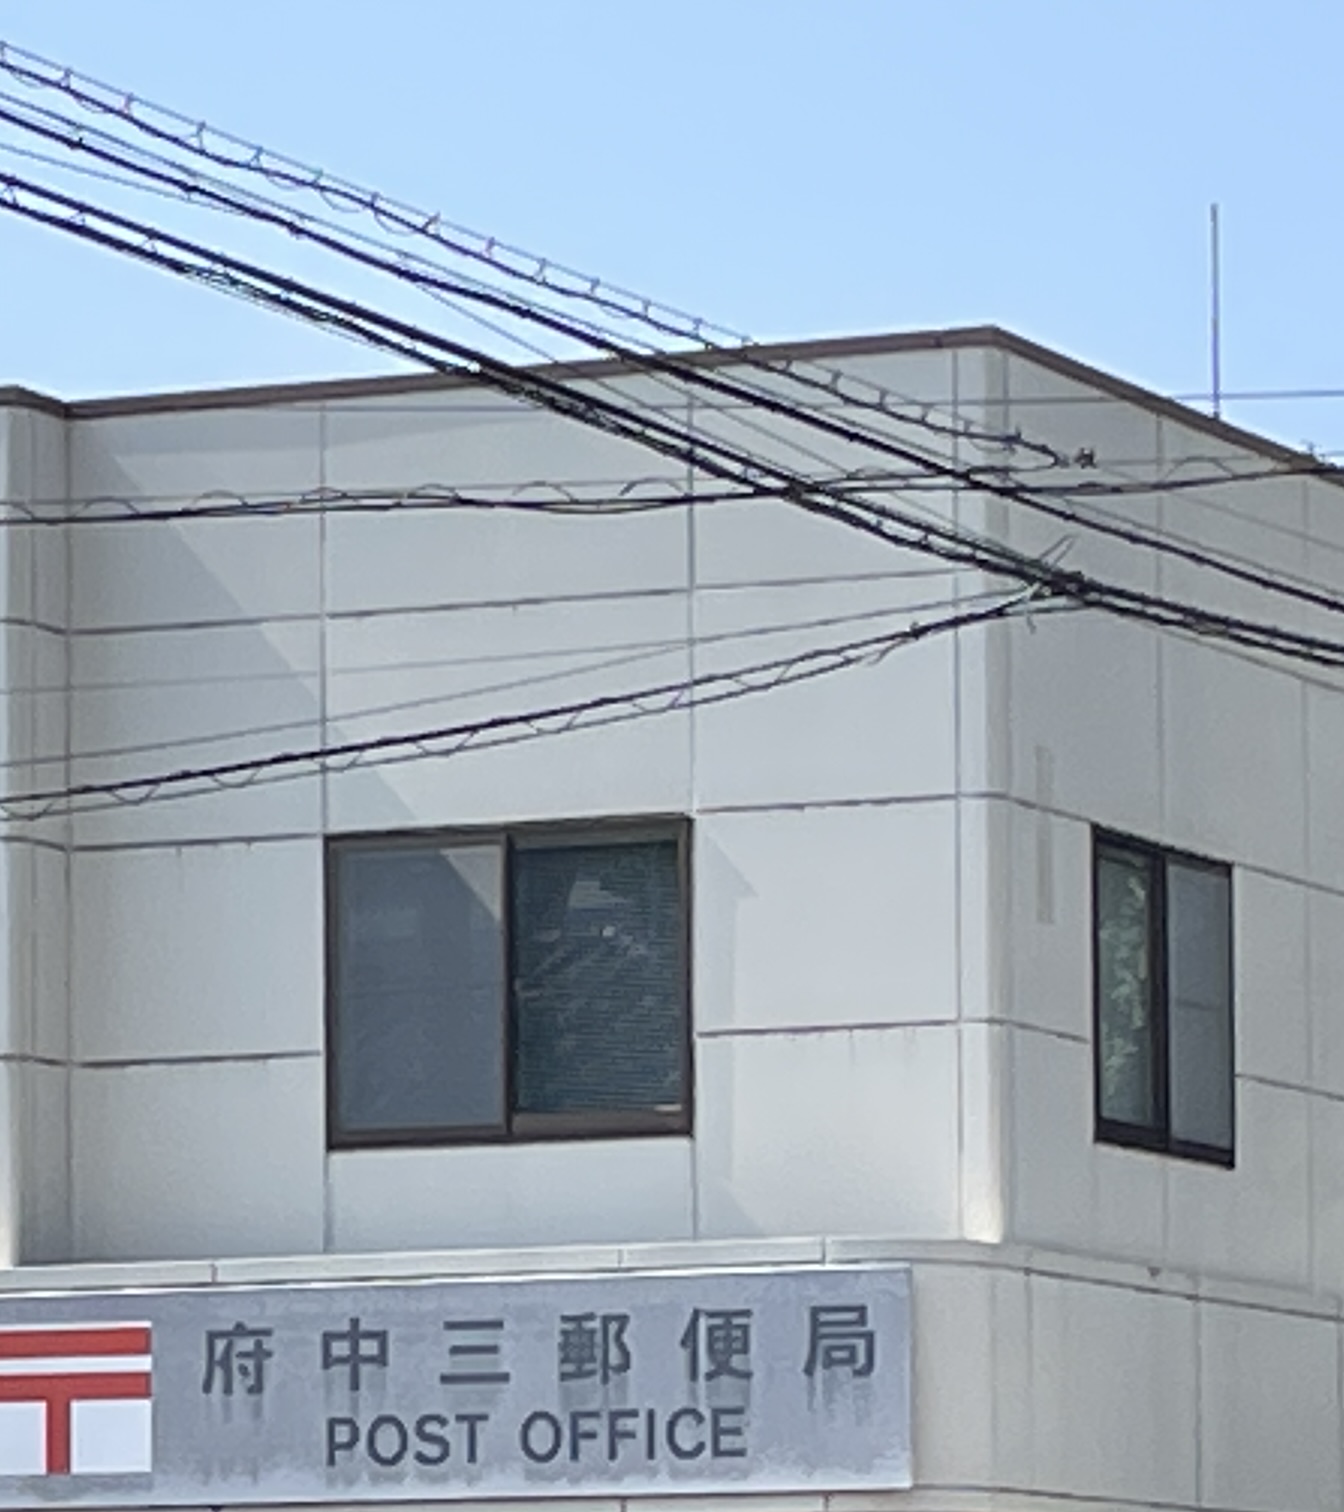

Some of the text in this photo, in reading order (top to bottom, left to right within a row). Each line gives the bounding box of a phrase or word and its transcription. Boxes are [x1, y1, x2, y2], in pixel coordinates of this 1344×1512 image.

[201, 1303, 876, 1396] 府中三郵便局
[326, 1408, 748, 1467] POST OFFICE
